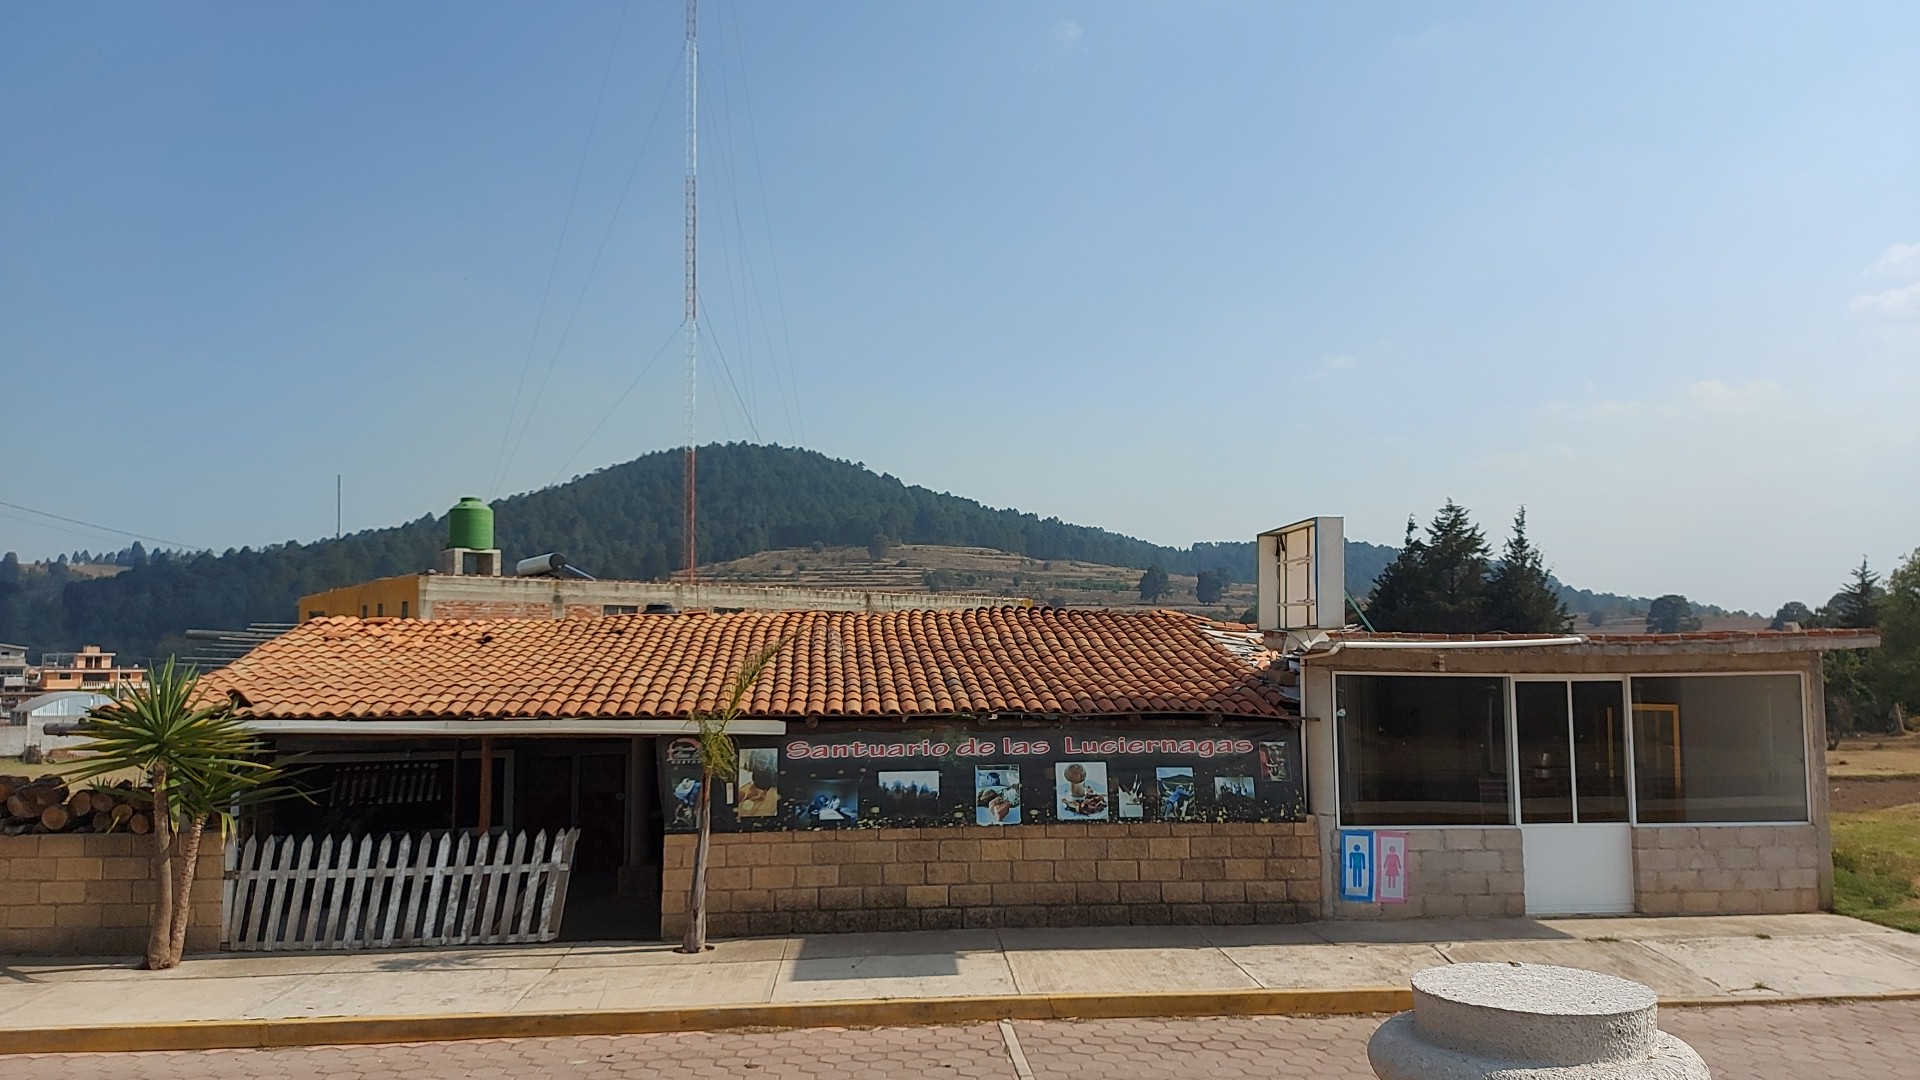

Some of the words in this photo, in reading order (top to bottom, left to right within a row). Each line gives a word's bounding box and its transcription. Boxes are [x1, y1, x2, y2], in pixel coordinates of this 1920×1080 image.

[786, 739, 950, 759] Santuario
[955, 737, 996, 756] de
[1003, 737, 1050, 755] las
[1064, 737, 1254, 758] Luciernagas
